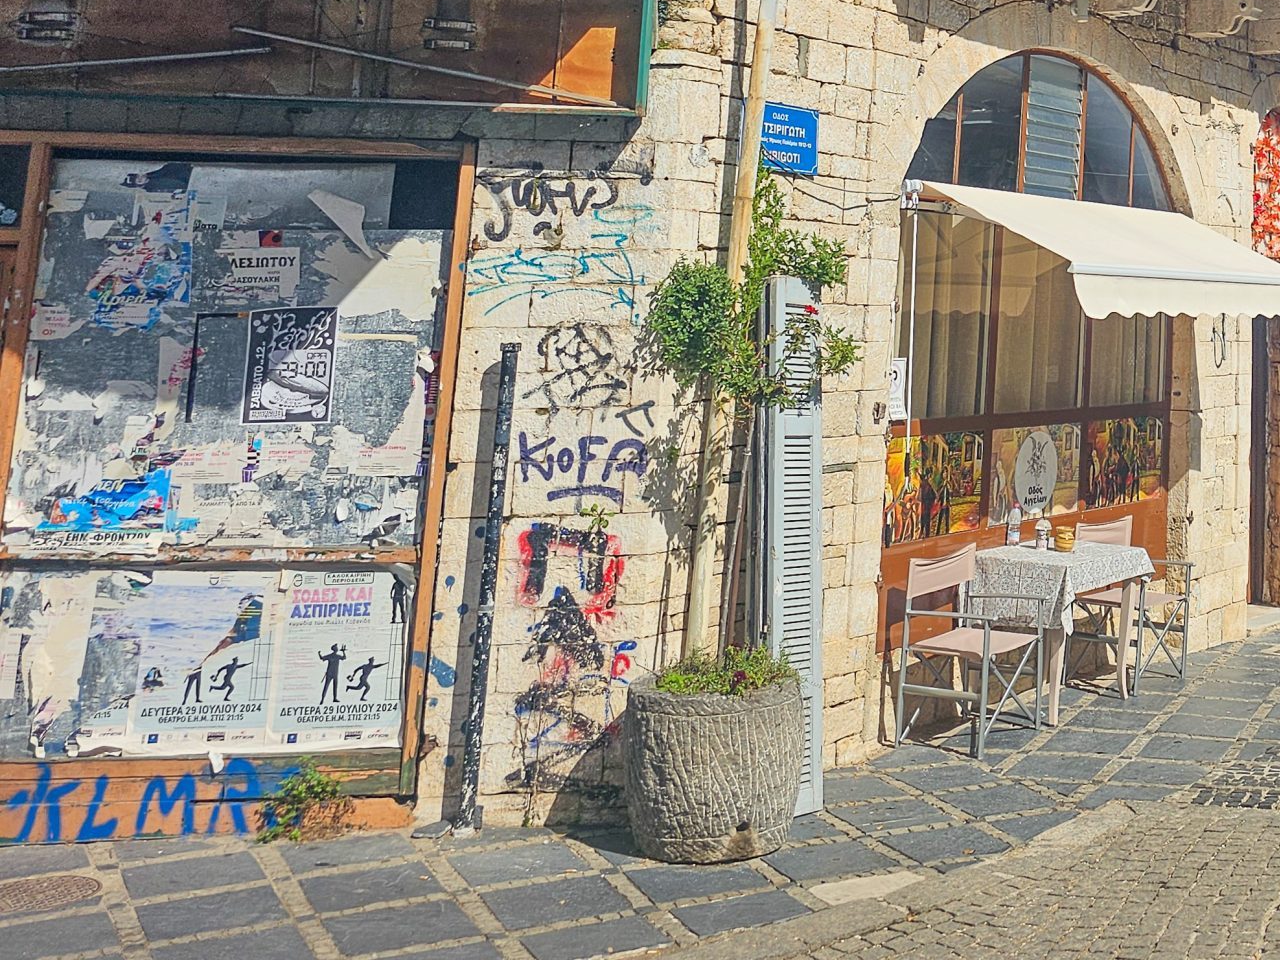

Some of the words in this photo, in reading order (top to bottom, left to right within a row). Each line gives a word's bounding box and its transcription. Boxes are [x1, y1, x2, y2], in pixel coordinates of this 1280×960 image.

[772, 112, 789, 121] ΟΔΟΣ
[763, 122, 806, 138] ΤΣΙΡΙΓΩΤΗ
[292, 588, 341, 604] ΣΟΔΕΣ
[345, 587, 374, 601] ΚΑΙ
[290, 602, 372, 619] ΑΣΠΙΡΙΝΕΣ
[140, 707, 183, 717] ΔΕΥΤΕΡΑ
[185, 706, 197, 715] 29
[199, 704, 238, 715] ΙΟΥΛΙΟΥ
[239, 703, 262, 713] 2024
[279, 706, 321, 717] ΔΕΥΤΕΡΑ
[323, 705, 335, 715] 29
[336, 703, 375, 714] ΙΟΥΛΙΟΥ
[376, 703, 398, 712] 2024
[158, 715, 187, 724] ΘΕΑΤΡΟ
[210, 713, 225, 721] ΣΤΙΣ
[226, 713, 244, 721] 21:15
[296, 715, 325, 724] ΘΕΑΤΡΟ
[347, 713, 362, 721] ΣΤΙΣ
[363, 712, 381, 721] 21:15
